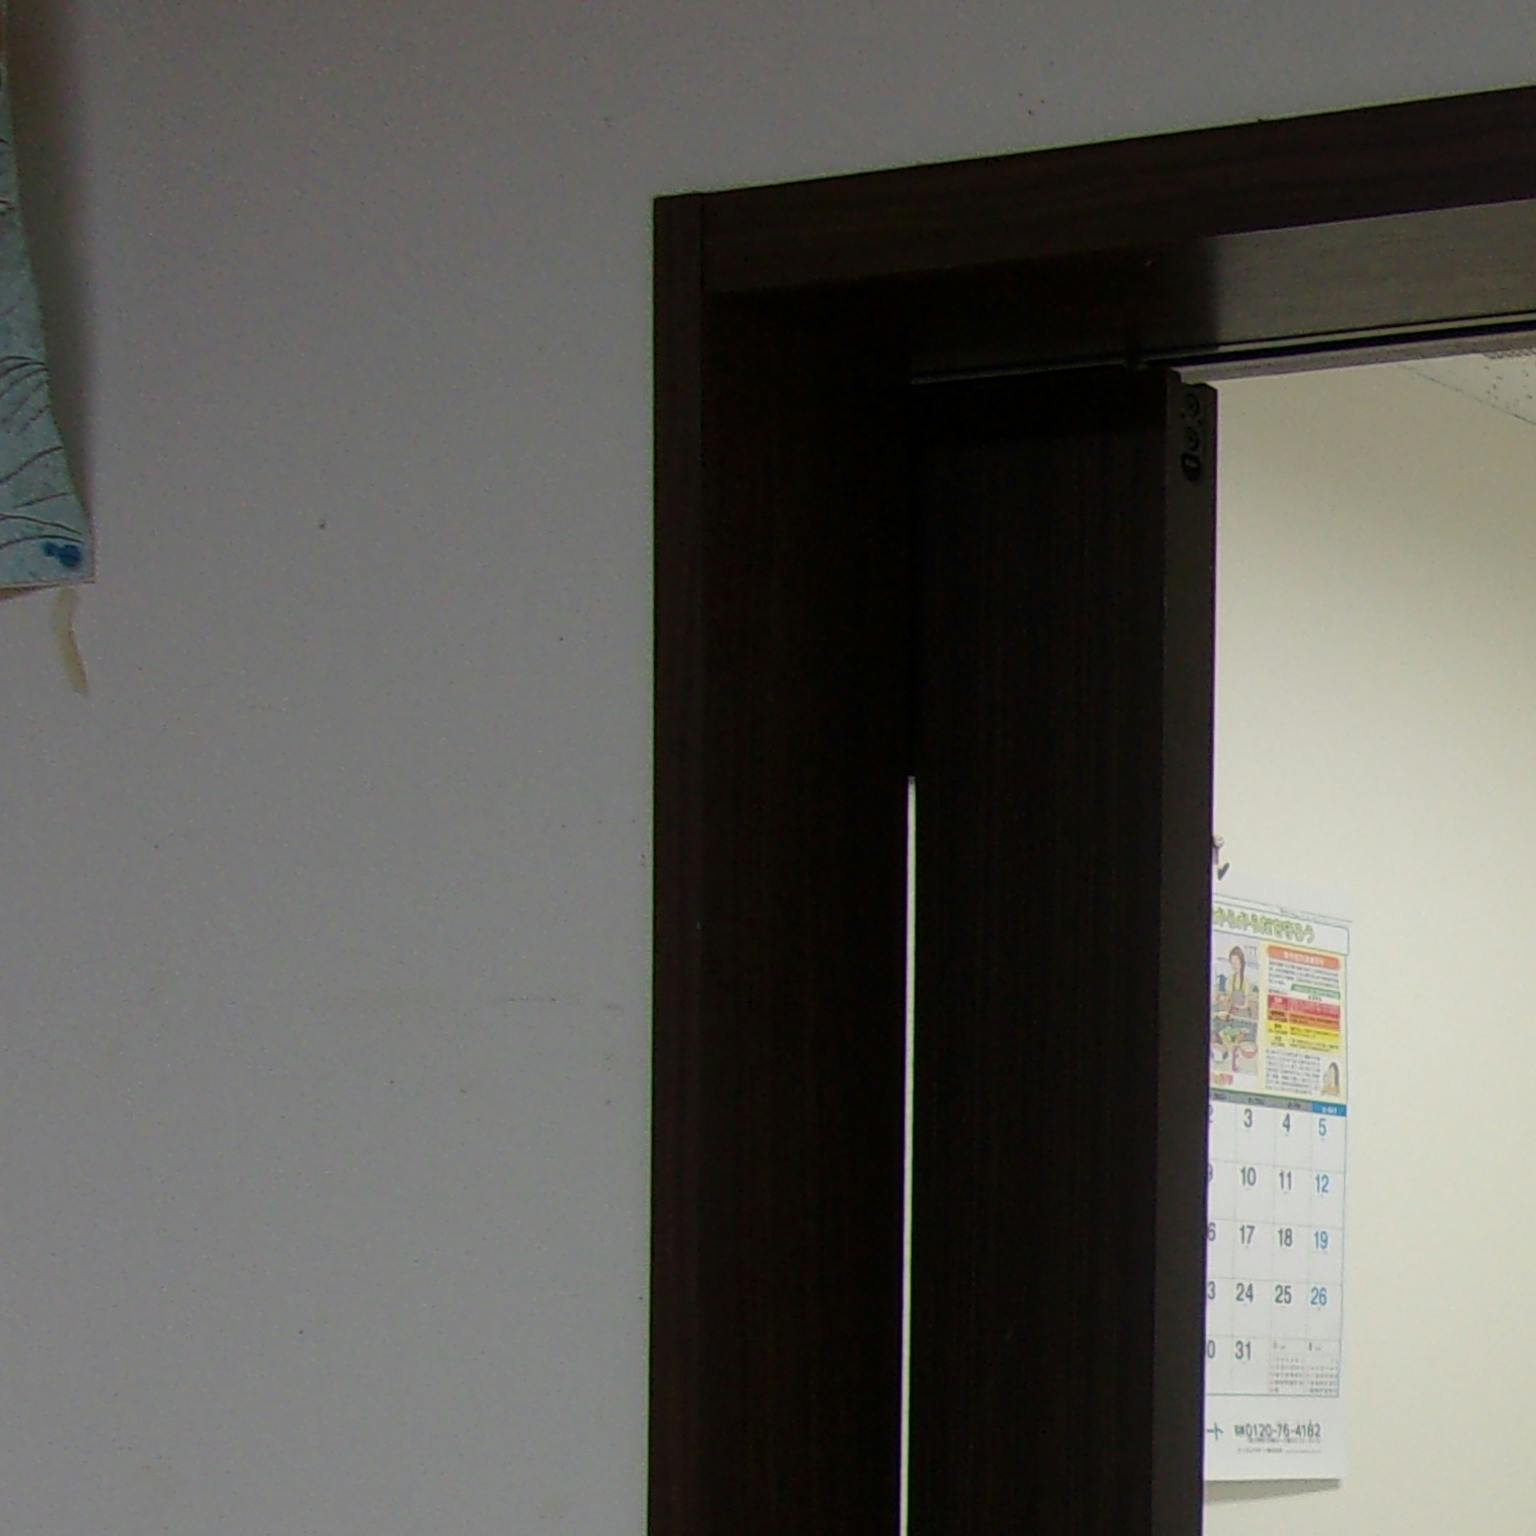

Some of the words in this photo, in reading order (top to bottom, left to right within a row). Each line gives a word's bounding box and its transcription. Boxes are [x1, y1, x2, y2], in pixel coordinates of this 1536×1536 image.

[1243, 1108, 1253, 1128] 3
[1282, 1112, 1291, 1132] 4
[1318, 1117, 1327, 1136] 5
[1240, 1166, 1256, 1186] 10
[1279, 1169, 1292, 1190] 11
[1315, 1173, 1329, 1193] 12
[1206, 1222, 1216, 1241] 6
[1239, 1224, 1255, 1244] 17
[1278, 1228, 1293, 1247] 18
[1314, 1230, 1329, 1249] 19
[1207, 1281, 1216, 1300] 3
[1235, 1282, 1254, 1302] 24
[1274, 1284, 1292, 1304] 25
[1310, 1286, 1328, 1306] 26
[1206, 1339, 1216, 1359] 0
[1234, 1339, 1252, 1360] 31
